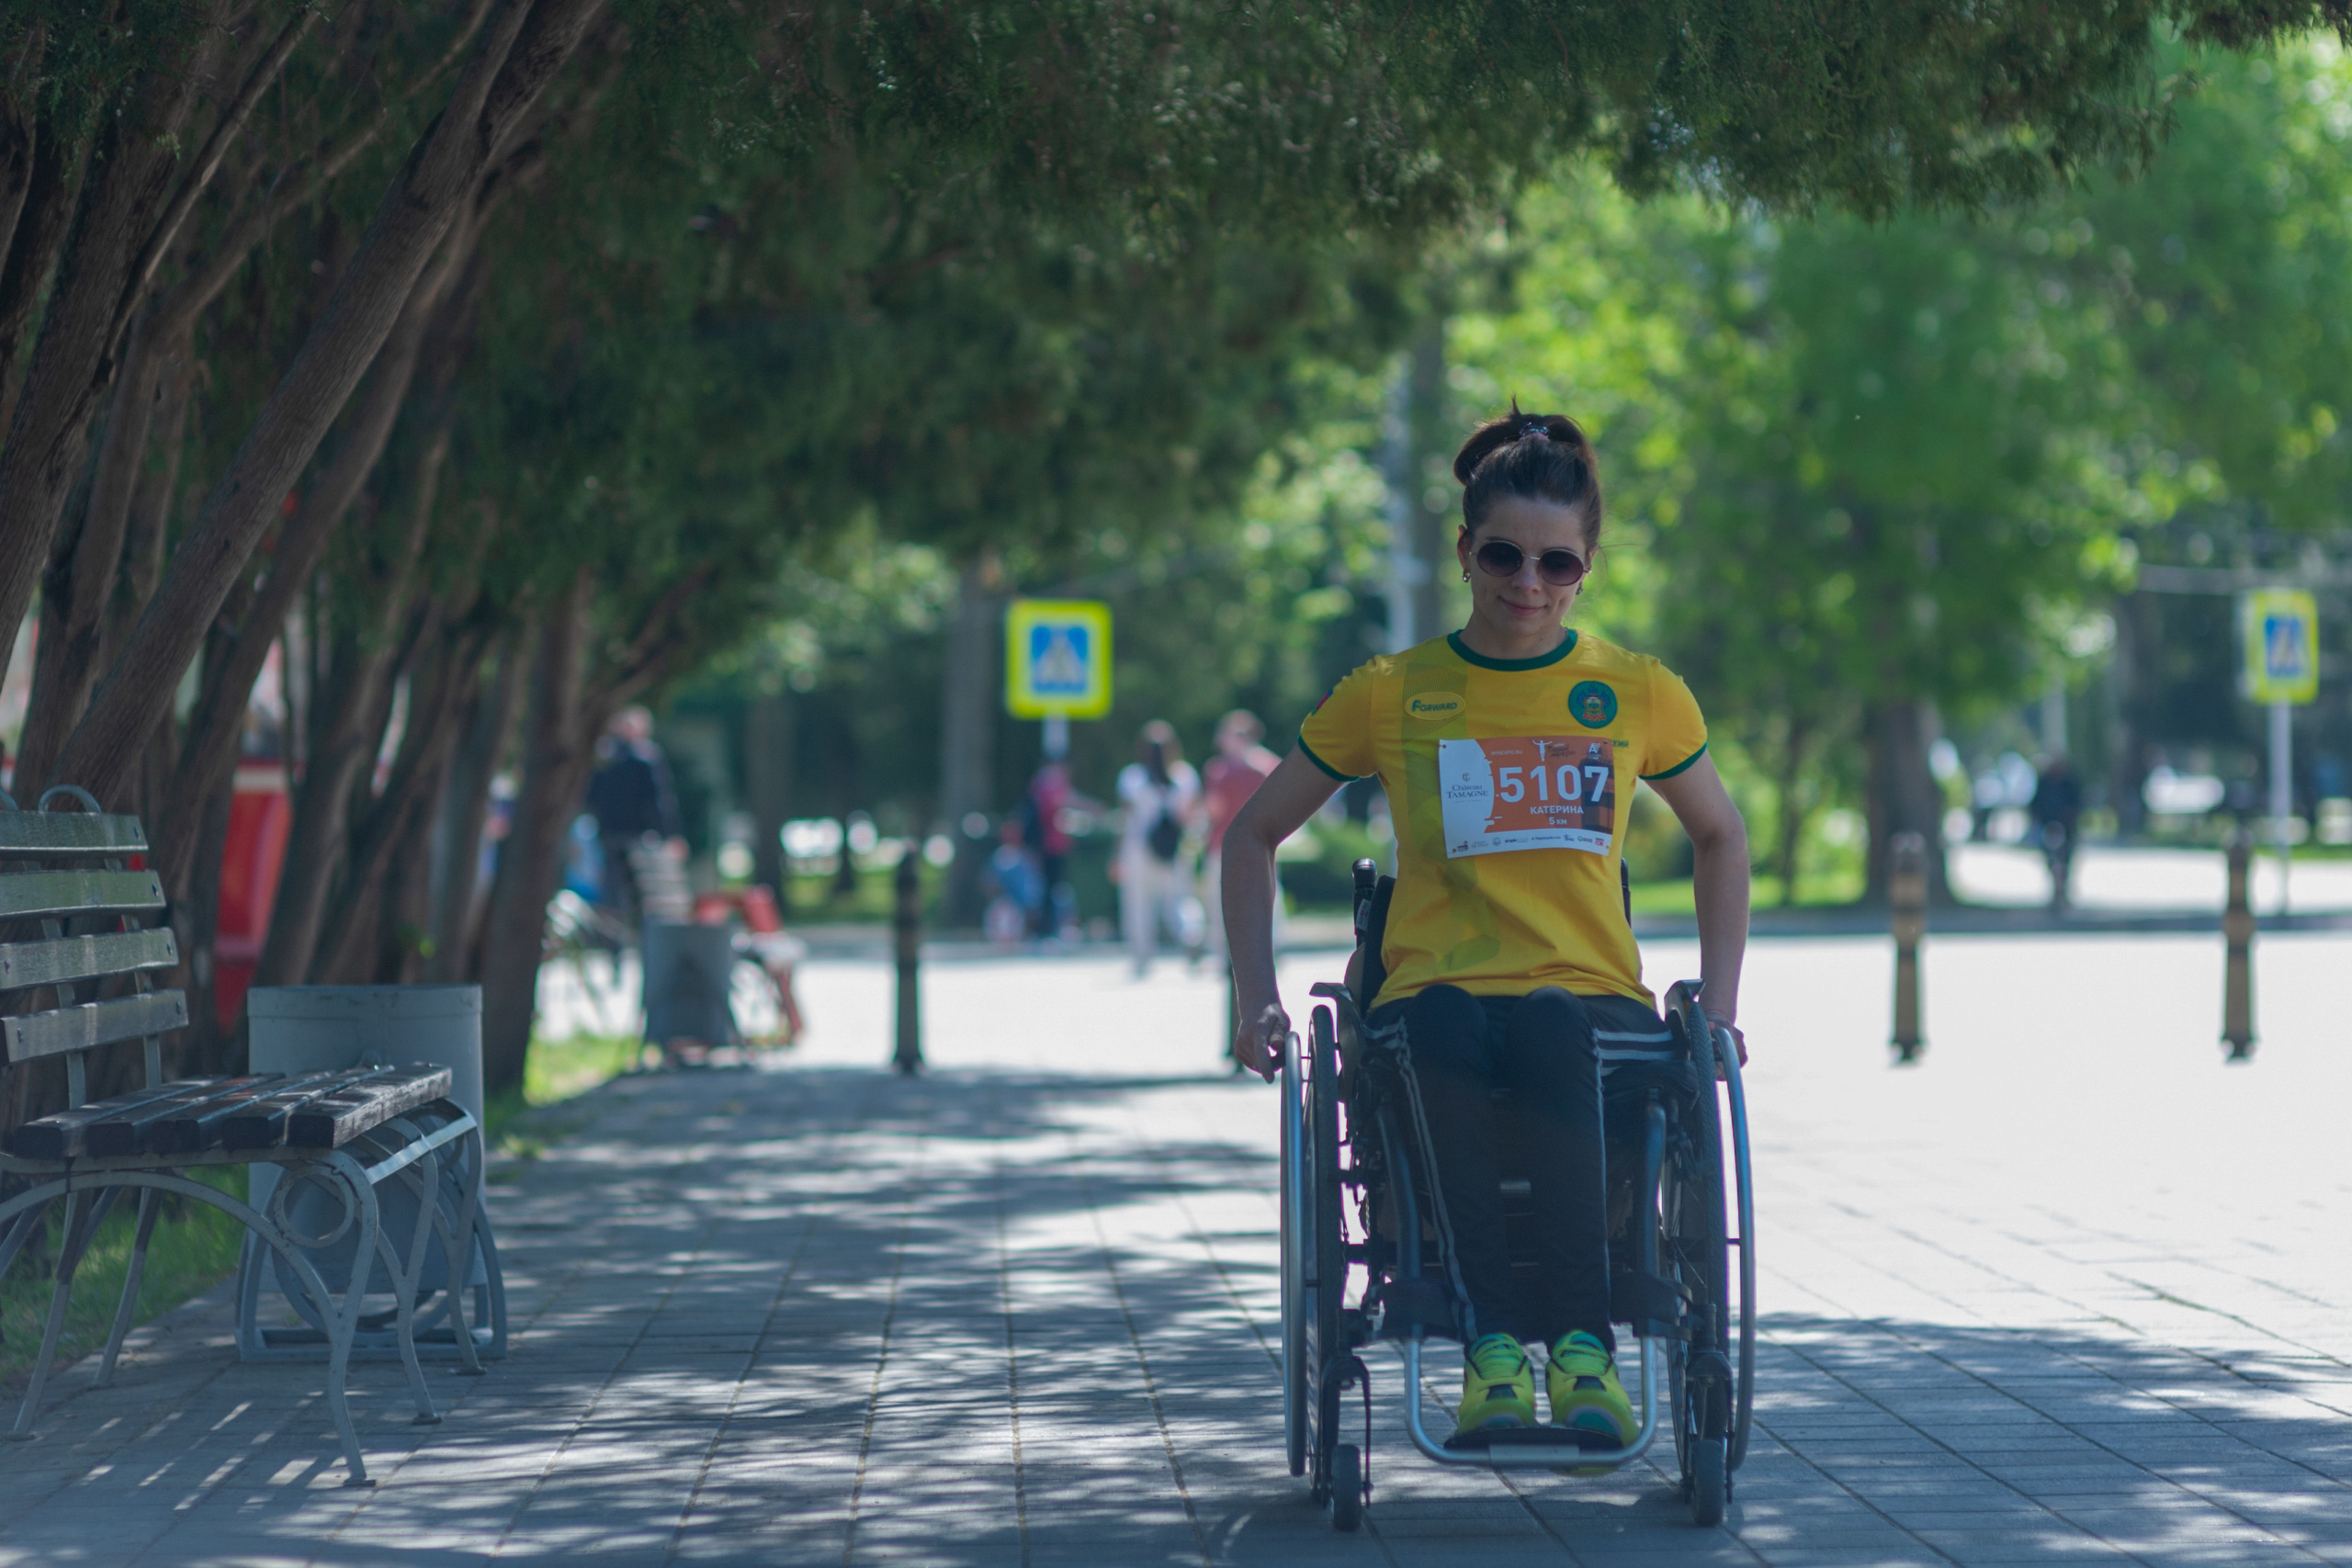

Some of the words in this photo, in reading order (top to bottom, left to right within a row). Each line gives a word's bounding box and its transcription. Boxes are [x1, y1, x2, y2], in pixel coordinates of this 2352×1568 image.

[1411, 699, 1458, 712] FORWARD
[1498, 764, 1610, 803] 5107
[1445, 790, 1489, 799] TAMAGNE
[1530, 805, 1585, 815] КАТЕРИНА
[1549, 817, 1555, 825] 5
